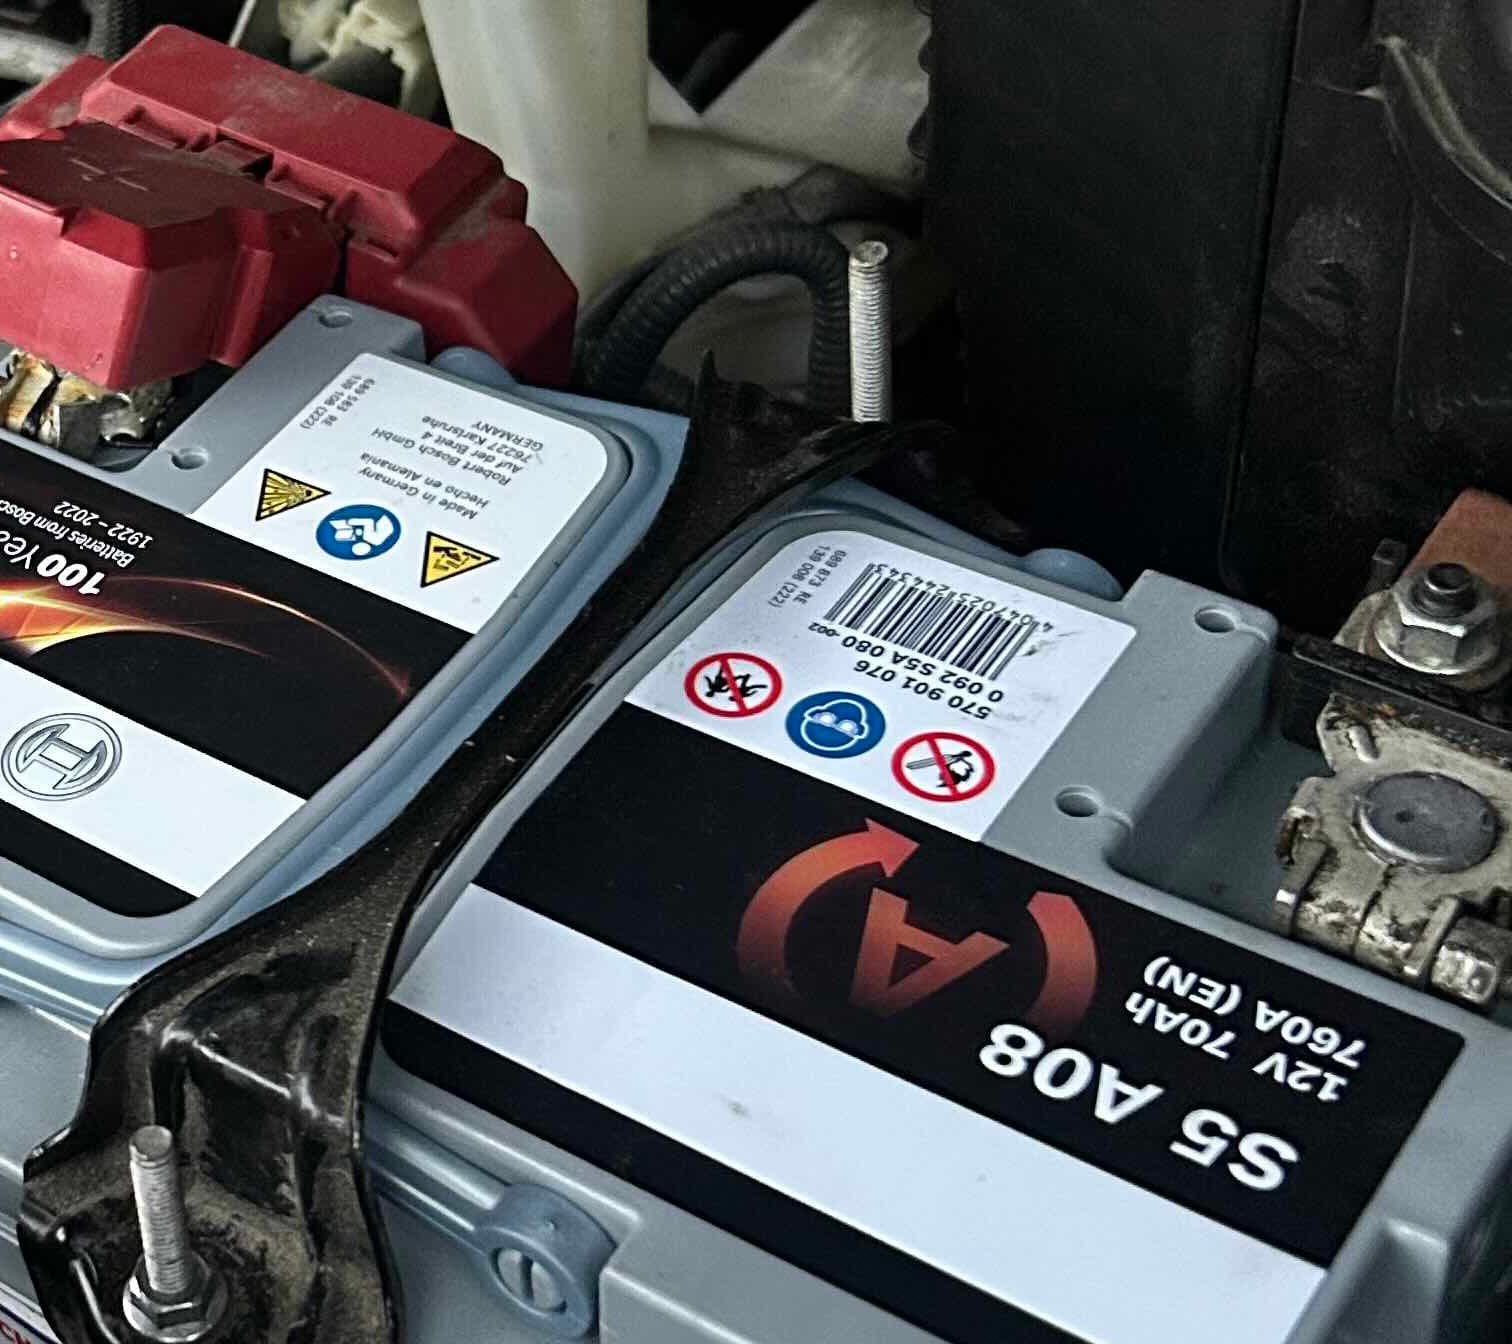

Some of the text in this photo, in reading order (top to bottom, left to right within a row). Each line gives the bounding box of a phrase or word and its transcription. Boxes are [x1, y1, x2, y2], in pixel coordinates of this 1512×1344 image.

[299, 406, 328, 429] (222)
[421, 431, 523, 474] Auf der Breit 4
[422, 415, 532, 463] 76227 Karlsruhe
[472, 420, 543, 452] GERMANY
[371, 427, 512, 487] Robert Bosch GmbH
[358, 466, 478, 520] Made in Germany
[360, 452, 490, 508] Hecho en Alemania
[33, 515, 70, 541] from
[53, 501, 100, 527] 2022
[67, 529, 136, 568] Batteries
[106, 523, 154, 549] 1922
[808, 545, 830, 562] 139
[36, 553, 105, 596] 100
[768, 582, 798, 608] (222)
[841, 634, 885, 658] 080
[890, 650, 936, 677] S5A
[854, 660, 992, 720] 570 901 076
[938, 670, 984, 695] 092
[988, 689, 1004, 703] 0
[1142, 956, 1369, 1068] 760A (EN)
[1125, 990, 1349, 1103] 12V 70Ah
[978, 1022, 1300, 1192] S5 A08
